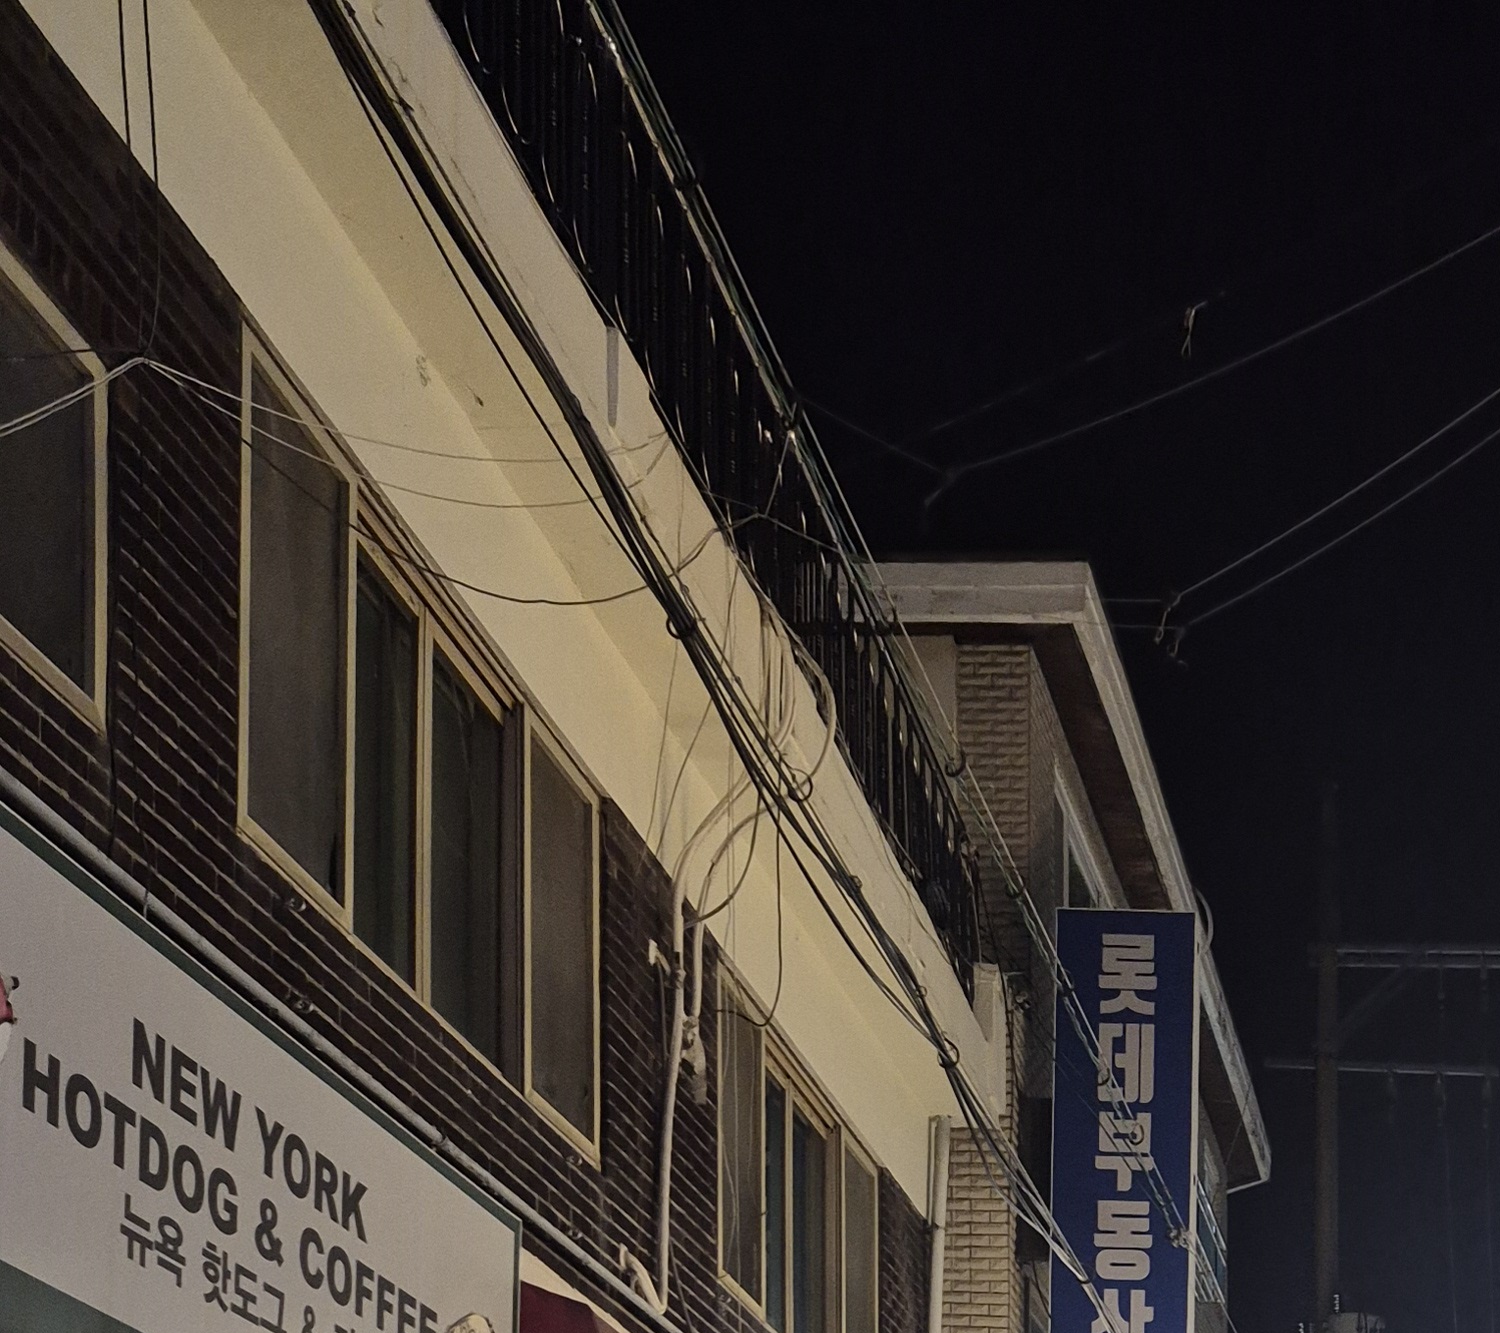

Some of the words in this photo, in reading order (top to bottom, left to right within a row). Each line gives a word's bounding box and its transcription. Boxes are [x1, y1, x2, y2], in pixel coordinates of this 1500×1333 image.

[22, 1037, 238, 1236] HOTDOG
[254, 1198, 284, 1267] &
[120, 1193, 186, 1288] 뉴욕
[131, 1016, 241, 1151] NEW
[254, 1106, 367, 1242] YORK
